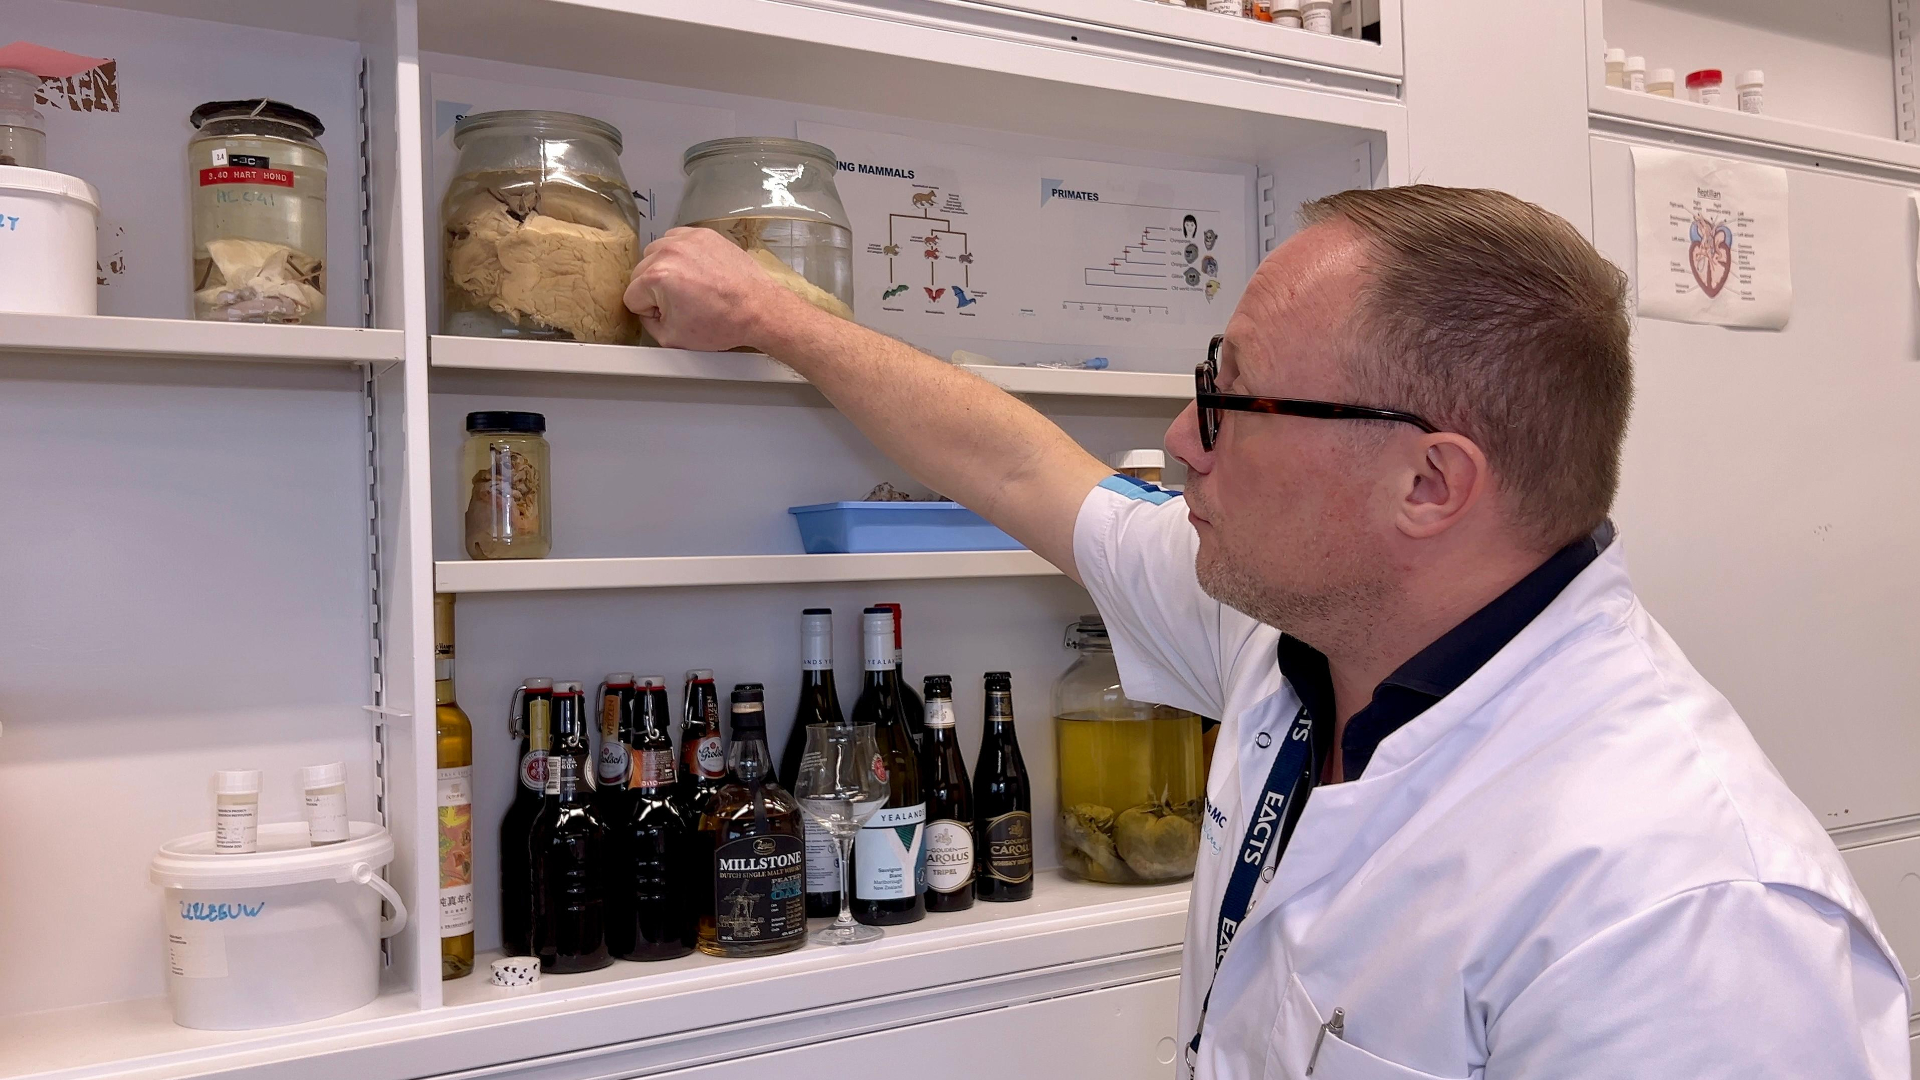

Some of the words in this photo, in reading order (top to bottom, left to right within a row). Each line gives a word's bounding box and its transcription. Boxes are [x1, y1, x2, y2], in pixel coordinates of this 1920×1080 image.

[208, 171, 228, 180] 3.40
[233, 171, 257, 179] HART
[263, 172, 287, 182] HOND
[858, 163, 915, 179] MAMMALS
[1051, 188, 1099, 202] PRIMATES
[1697, 187, 1721, 198] Reptilian
[606, 699, 614, 736] WEIZEN
[707, 695, 716, 731] WEIZEN
[698, 746, 723, 762] Grols
[1244, 791, 1285, 866] EACTS
[719, 851, 802, 871] MILLSTONE
[743, 870, 767, 878] SINGLE
